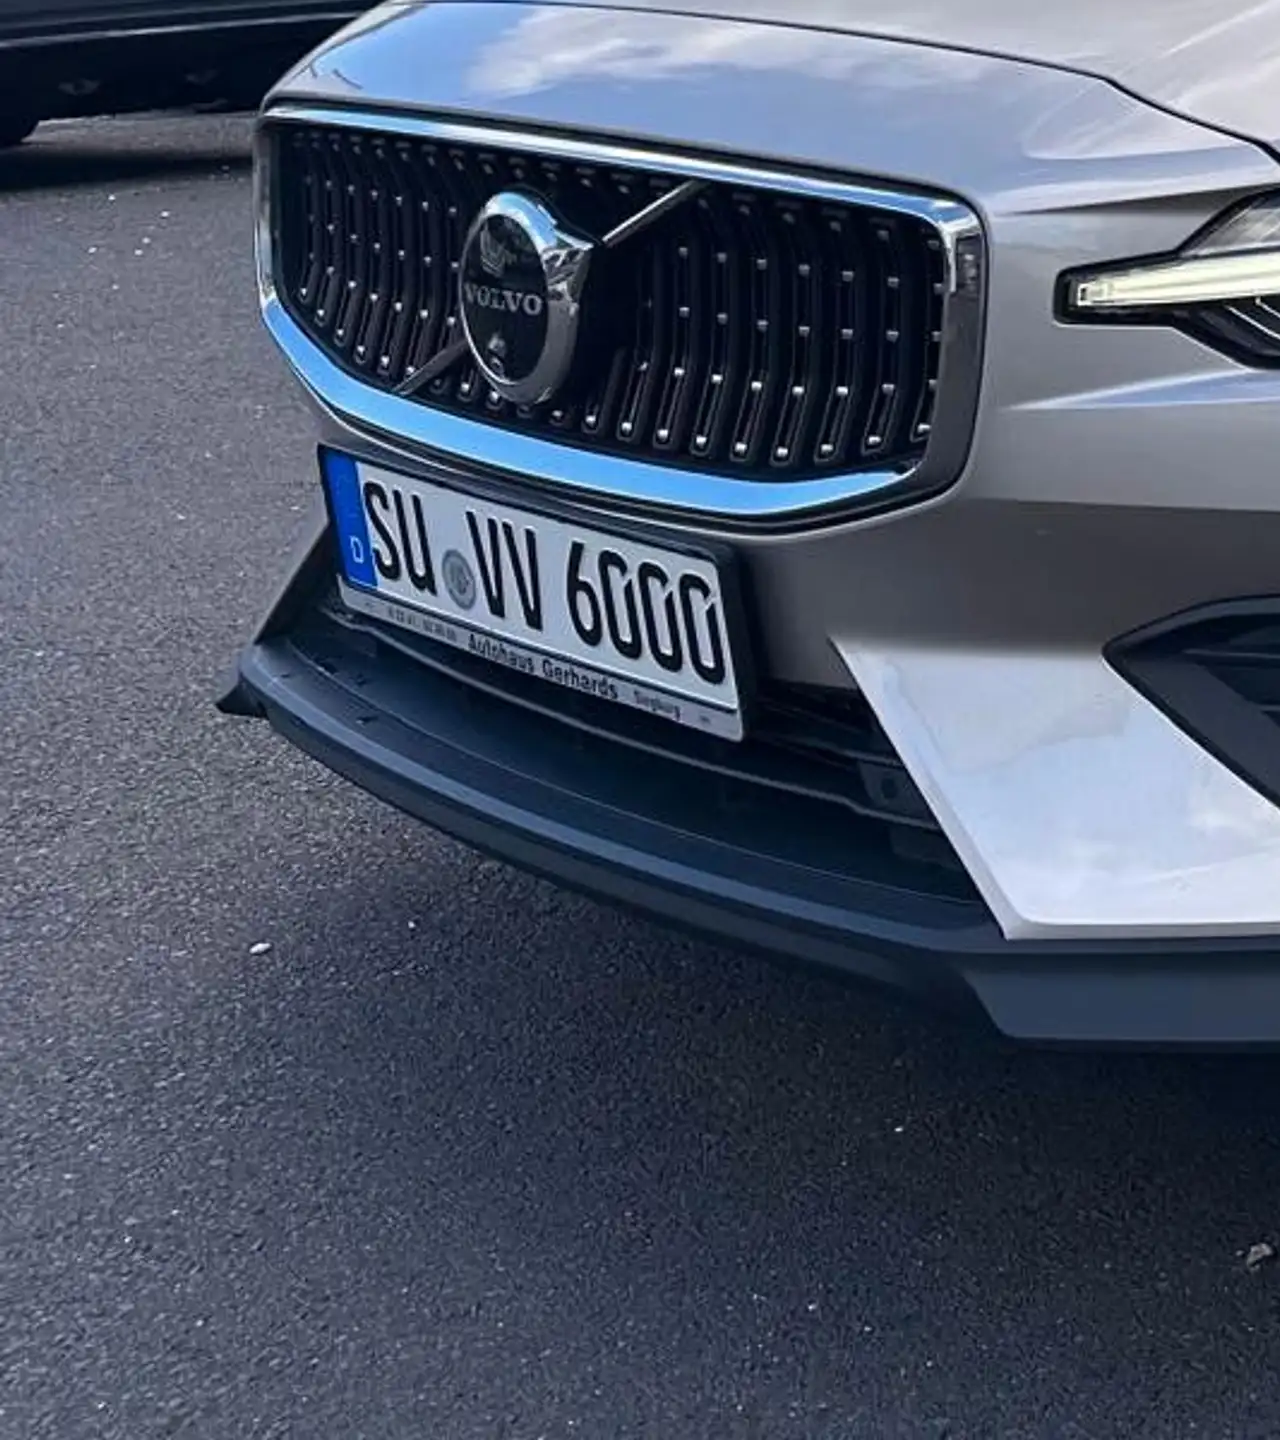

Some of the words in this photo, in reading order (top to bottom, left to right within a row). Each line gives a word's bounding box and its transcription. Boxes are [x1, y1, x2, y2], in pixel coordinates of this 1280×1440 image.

[463, 280, 543, 316] VOLVO
[350, 536, 365, 564] D
[363, 481, 437, 597] SU
[466, 509, 544, 633] VV
[566, 540, 726, 686] 6000
[466, 631, 536, 676] Autohaus
[541, 656, 620, 702] Gerhards
